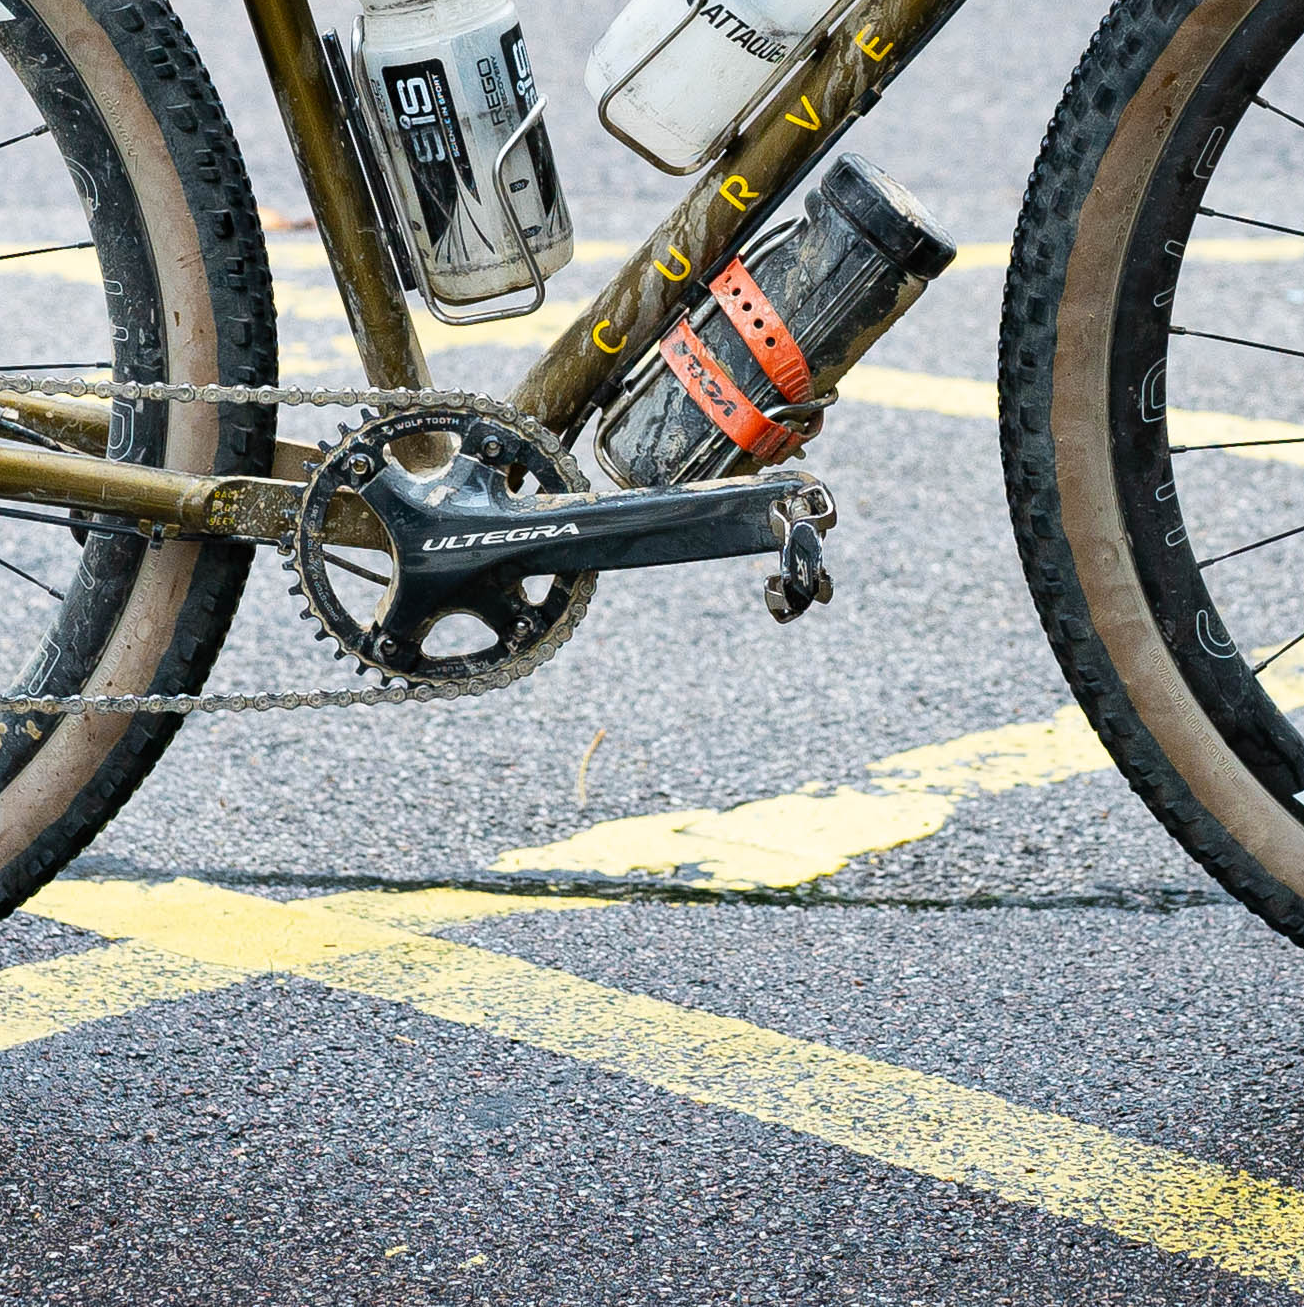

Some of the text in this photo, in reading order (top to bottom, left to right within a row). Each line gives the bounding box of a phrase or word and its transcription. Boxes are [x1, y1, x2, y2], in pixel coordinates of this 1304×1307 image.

[477, 57, 504, 126] REGO
[592, 23, 894, 354] CURVE
[395, 417, 460, 431] WOLF TOOTH
[422, 522, 580, 552] ULTEGRA
